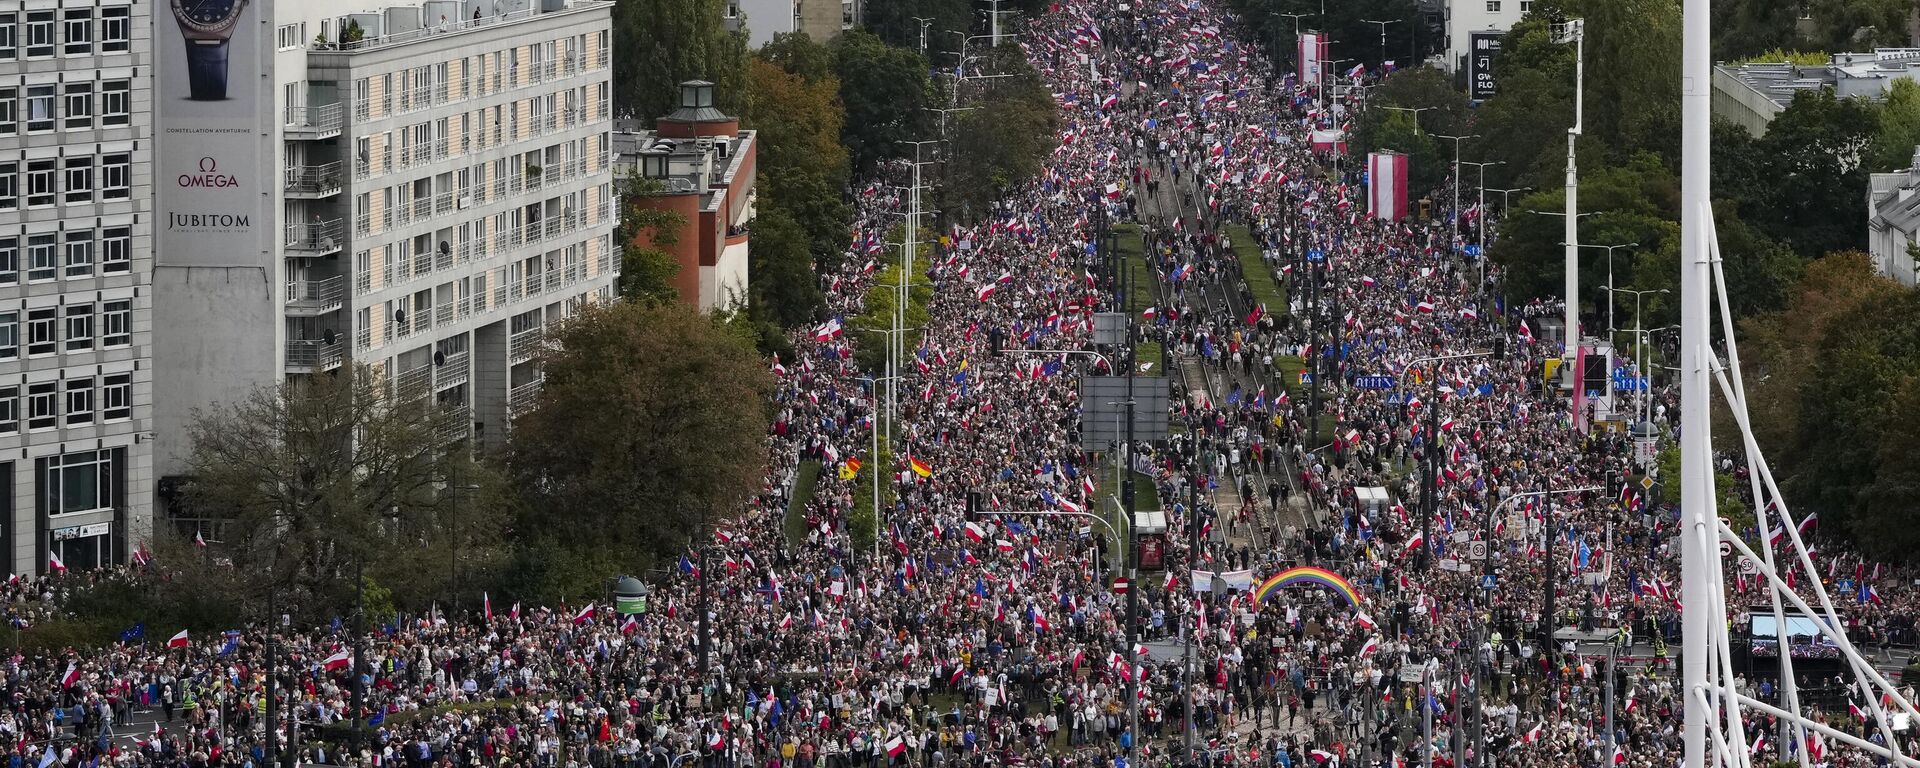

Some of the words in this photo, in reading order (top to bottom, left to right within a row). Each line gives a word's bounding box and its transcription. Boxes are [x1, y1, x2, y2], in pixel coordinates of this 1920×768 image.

[178, 174, 239, 188] OMEGA
[168, 211, 250, 230] JUBITOM
[1475, 546, 1484, 554] 50
